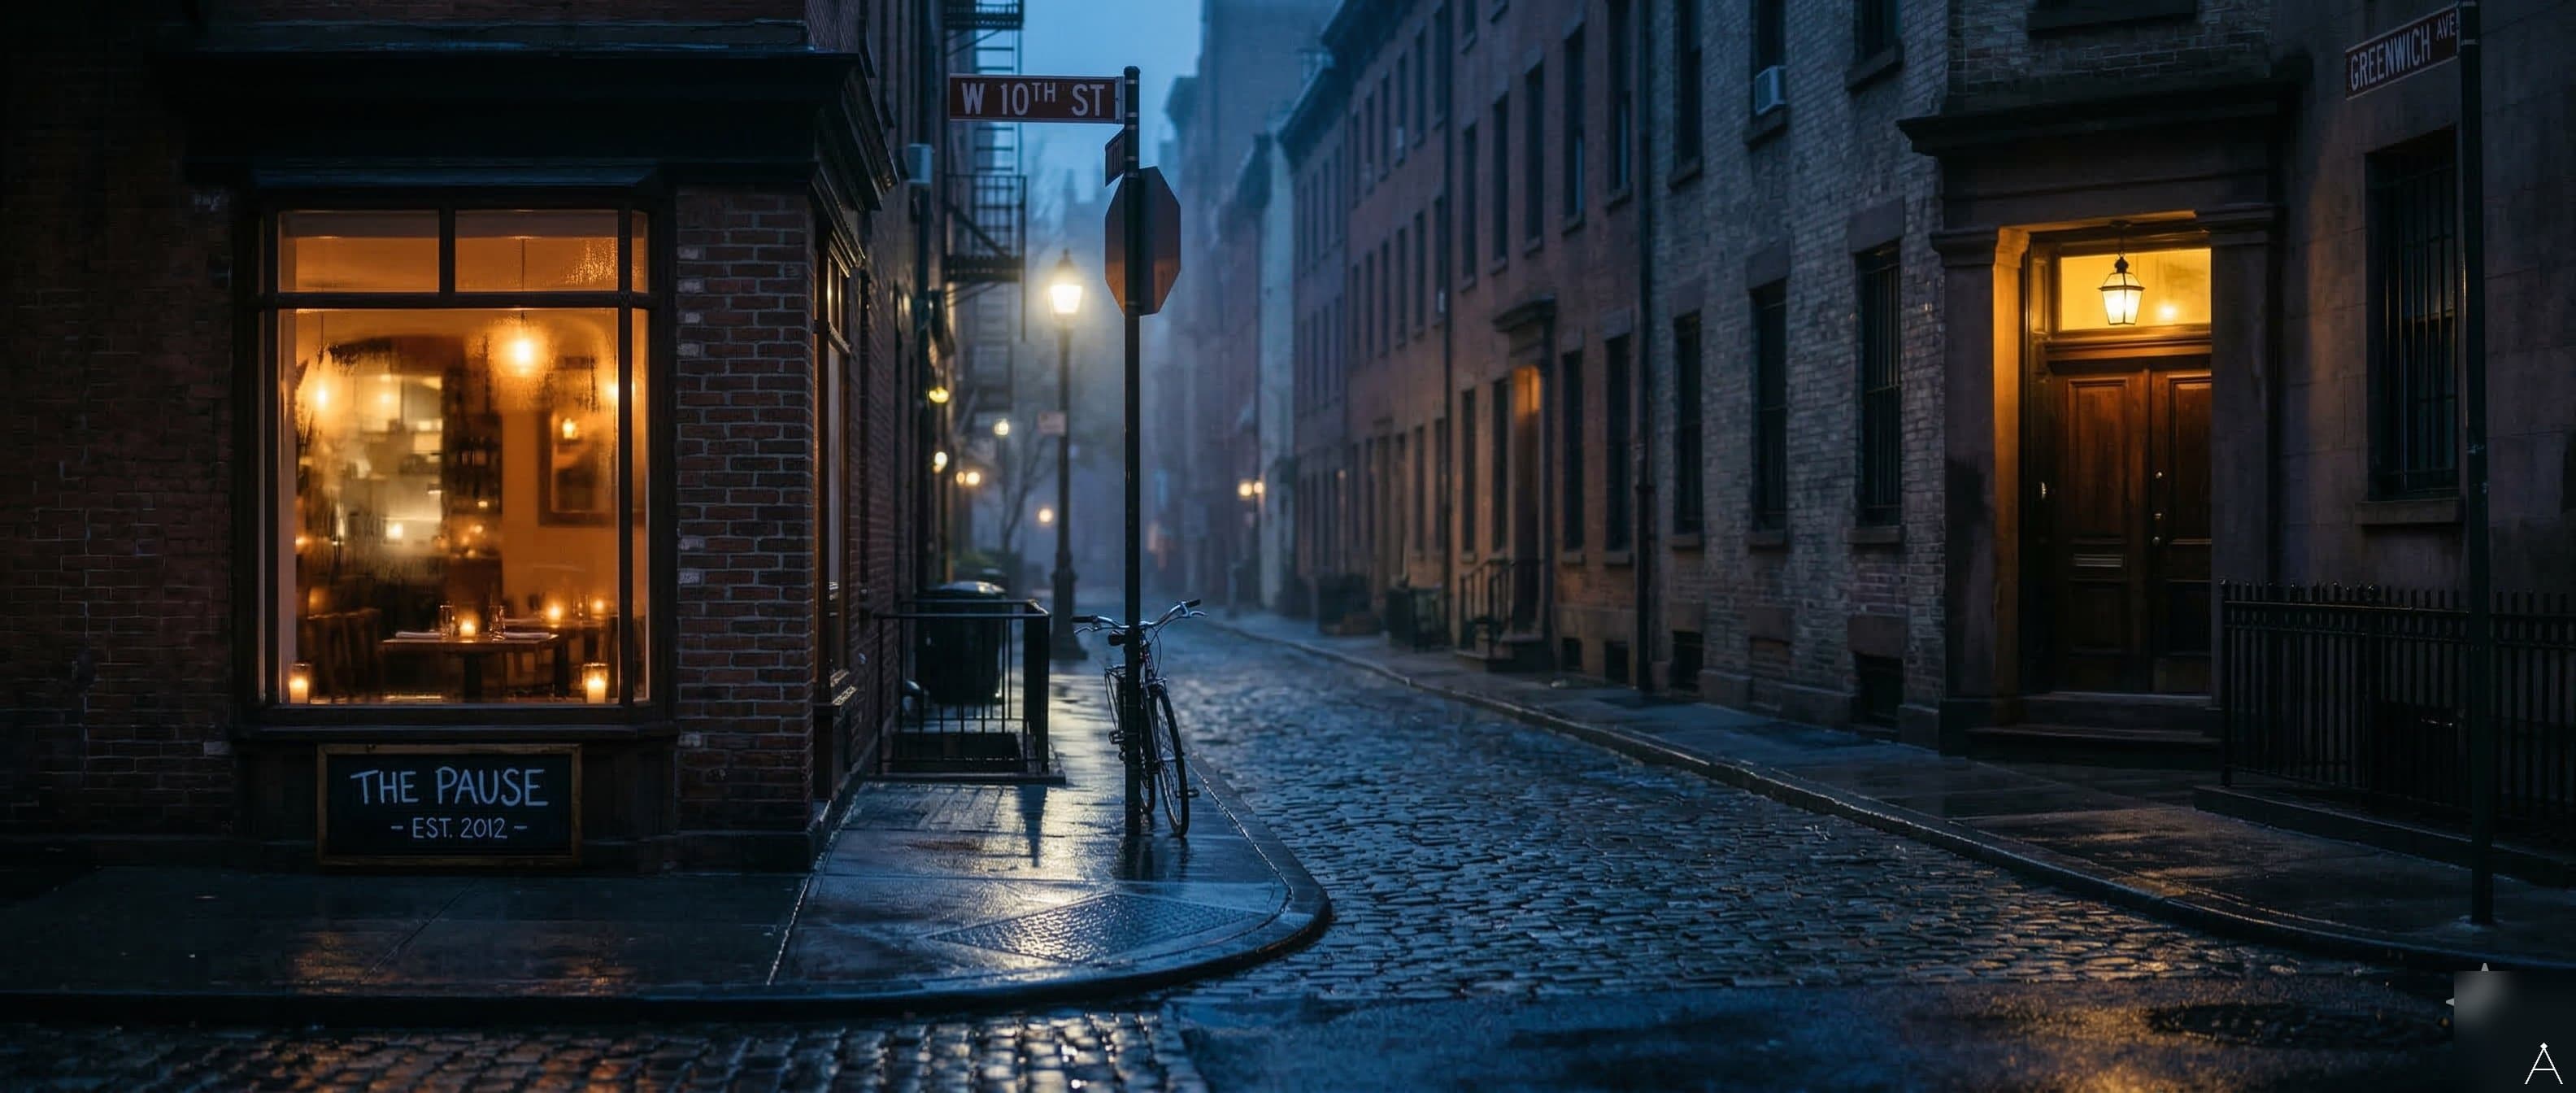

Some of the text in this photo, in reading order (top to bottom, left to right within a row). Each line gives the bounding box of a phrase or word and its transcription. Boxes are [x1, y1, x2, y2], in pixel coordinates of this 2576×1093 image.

[2351, 12, 2456, 91] GREENWICH AVE
[961, 82, 1105, 116] W 10TH ST
[350, 766, 549, 807] THE PAUSE
[412, 817, 453, 839] EST.
[459, 817, 508, 839] 2012
